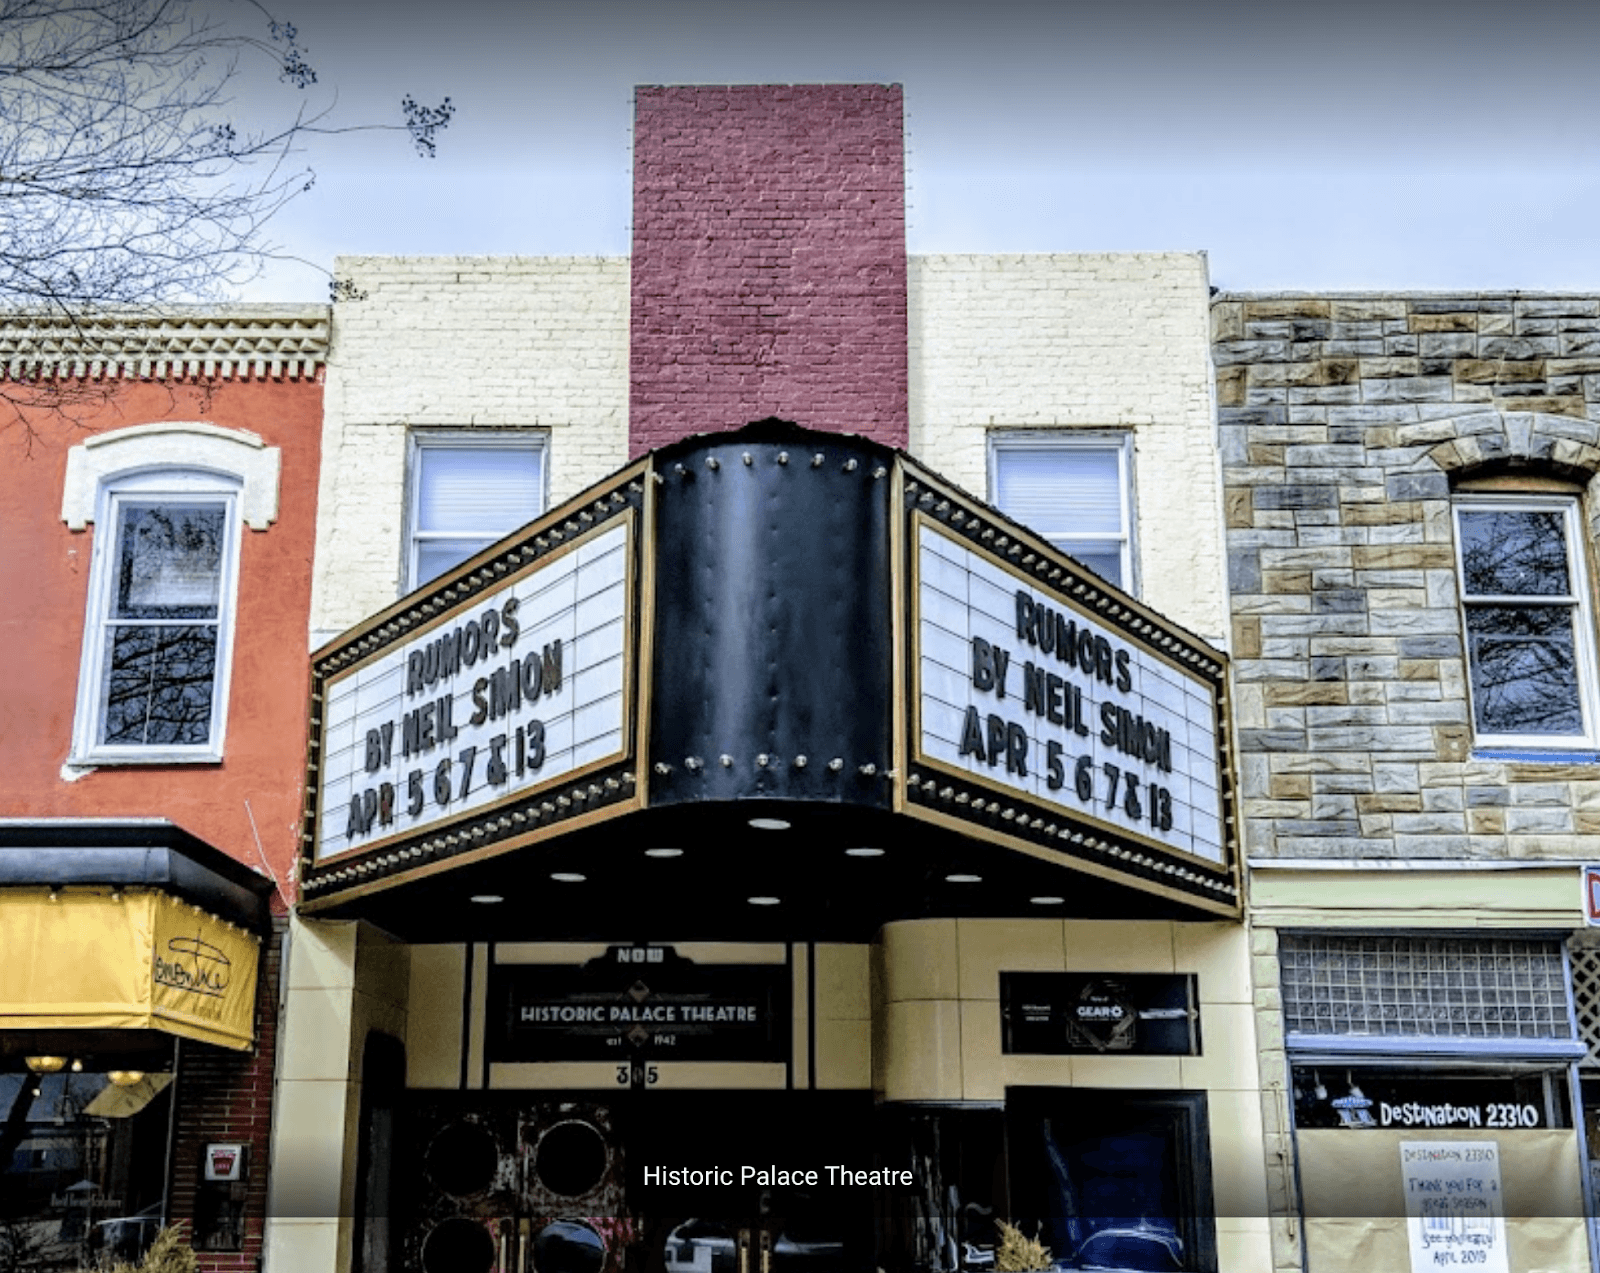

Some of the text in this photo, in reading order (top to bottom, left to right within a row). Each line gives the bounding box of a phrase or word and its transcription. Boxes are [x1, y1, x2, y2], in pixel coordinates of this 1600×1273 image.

[406, 597, 519, 697] RUMORS
[1015, 590, 1132, 693] RUMORS
[365, 639, 563, 773] BY NEIL SIMON
[972, 637, 1173, 773] BY NEIL SIMON
[346, 720, 547, 840] APR 5 6 7 & 13
[959, 705, 1028, 778] APR
[1046, 740, 1065, 791] 5
[1074, 756, 1093, 802] 6
[1150, 783, 1173, 832] 13
[520, 1005, 757, 1022] HISTORIC PALACE THEATRE
[1485, 1103, 1539, 1128] 23310
